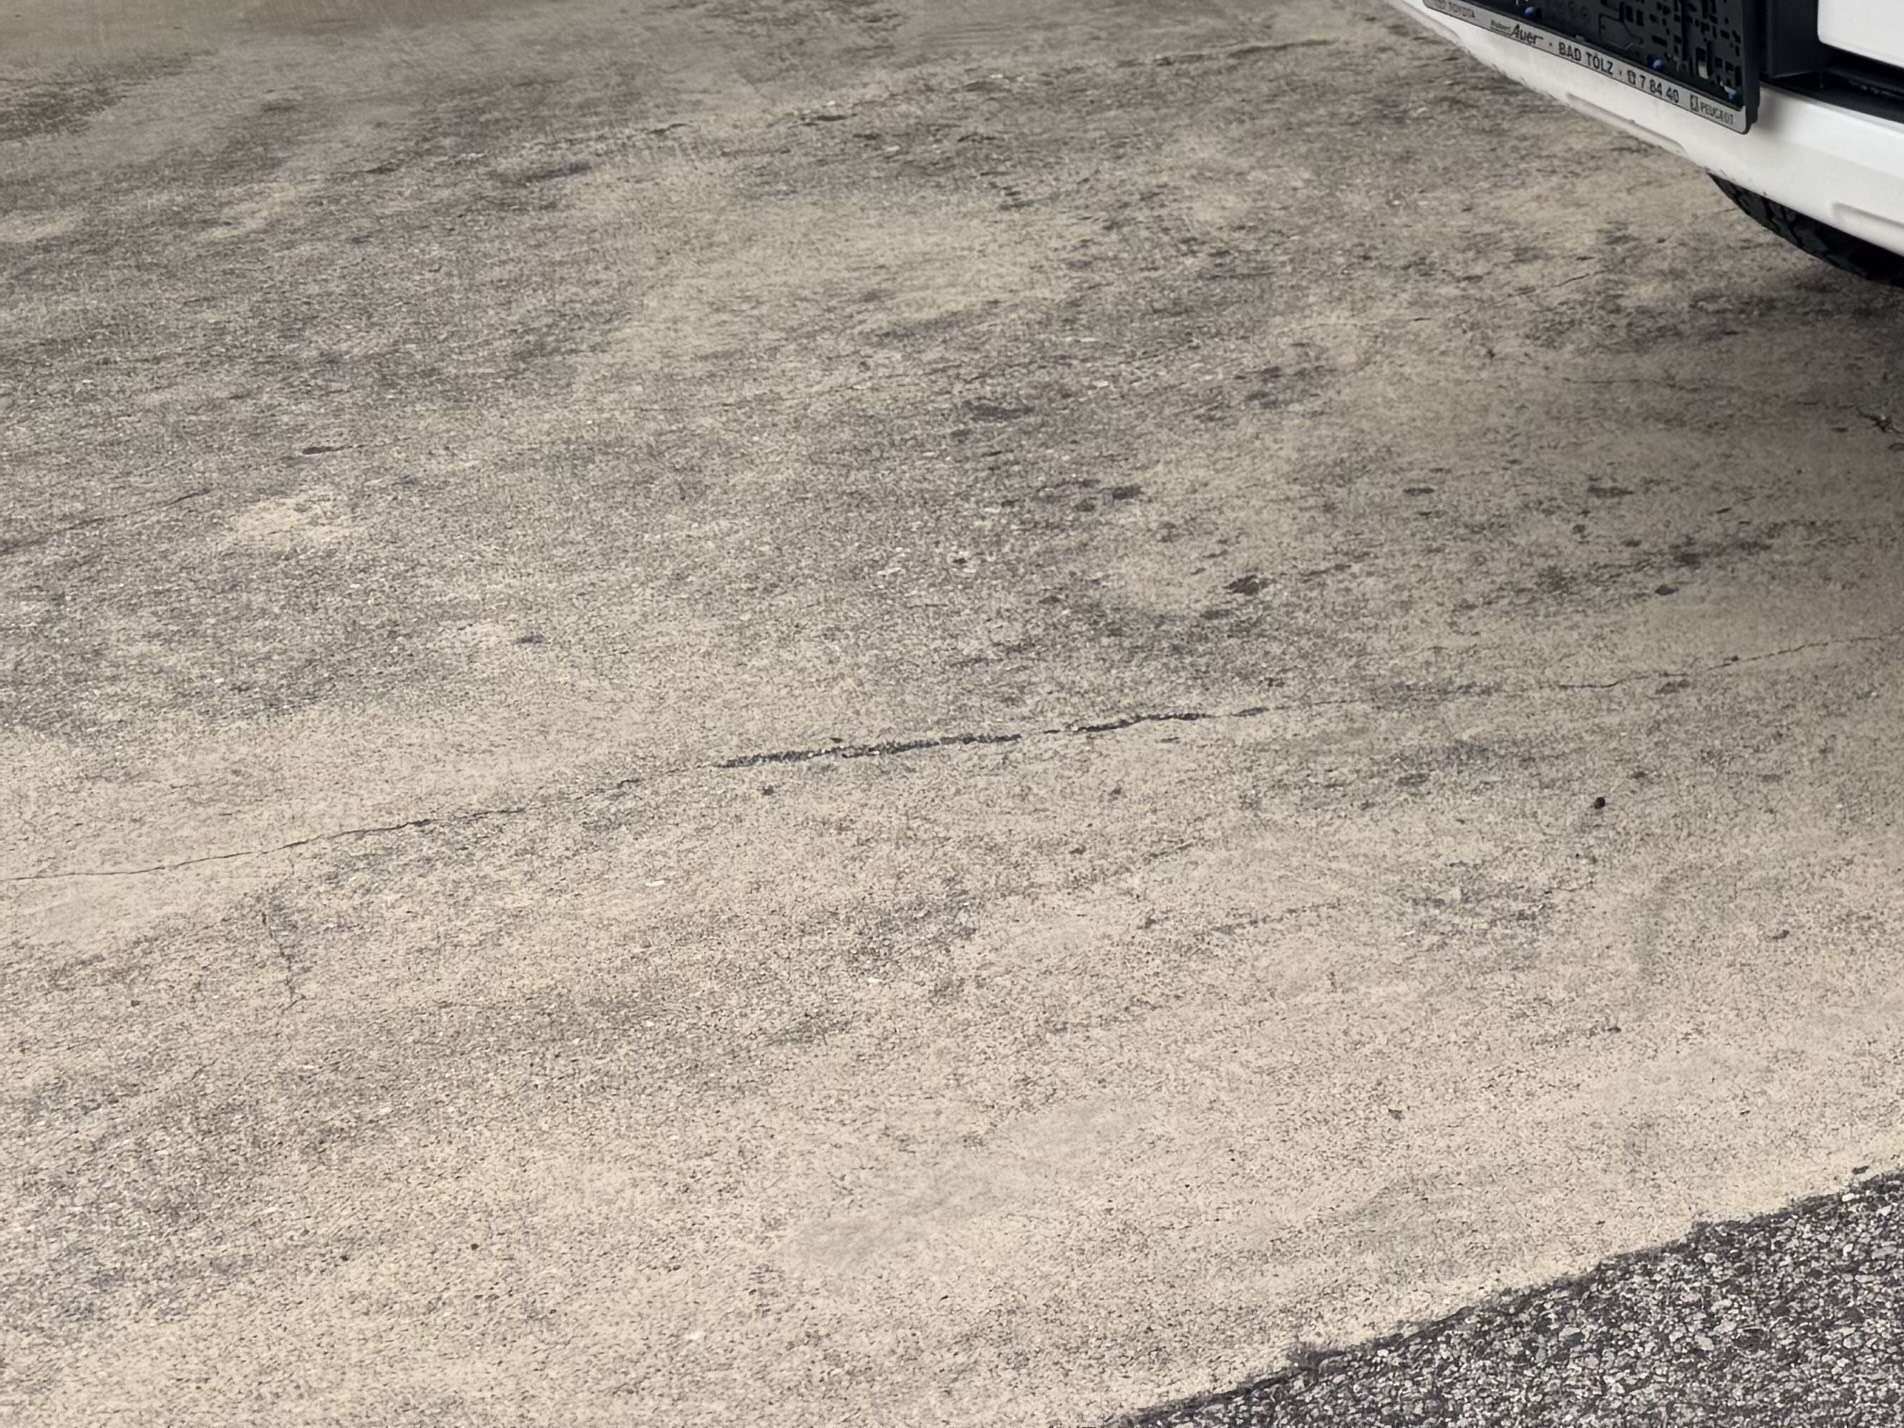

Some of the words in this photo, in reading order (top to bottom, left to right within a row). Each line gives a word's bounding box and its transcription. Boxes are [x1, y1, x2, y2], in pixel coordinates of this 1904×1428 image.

[1510, 23, 1544, 45] Auer
[1557, 41, 1582, 62] BAD
[1639, 74, 1646, 89] 7
[1650, 77, 1663, 97] 84
[1666, 87, 1680, 104] 40
[1699, 103, 1734, 126] PEUGEOT
